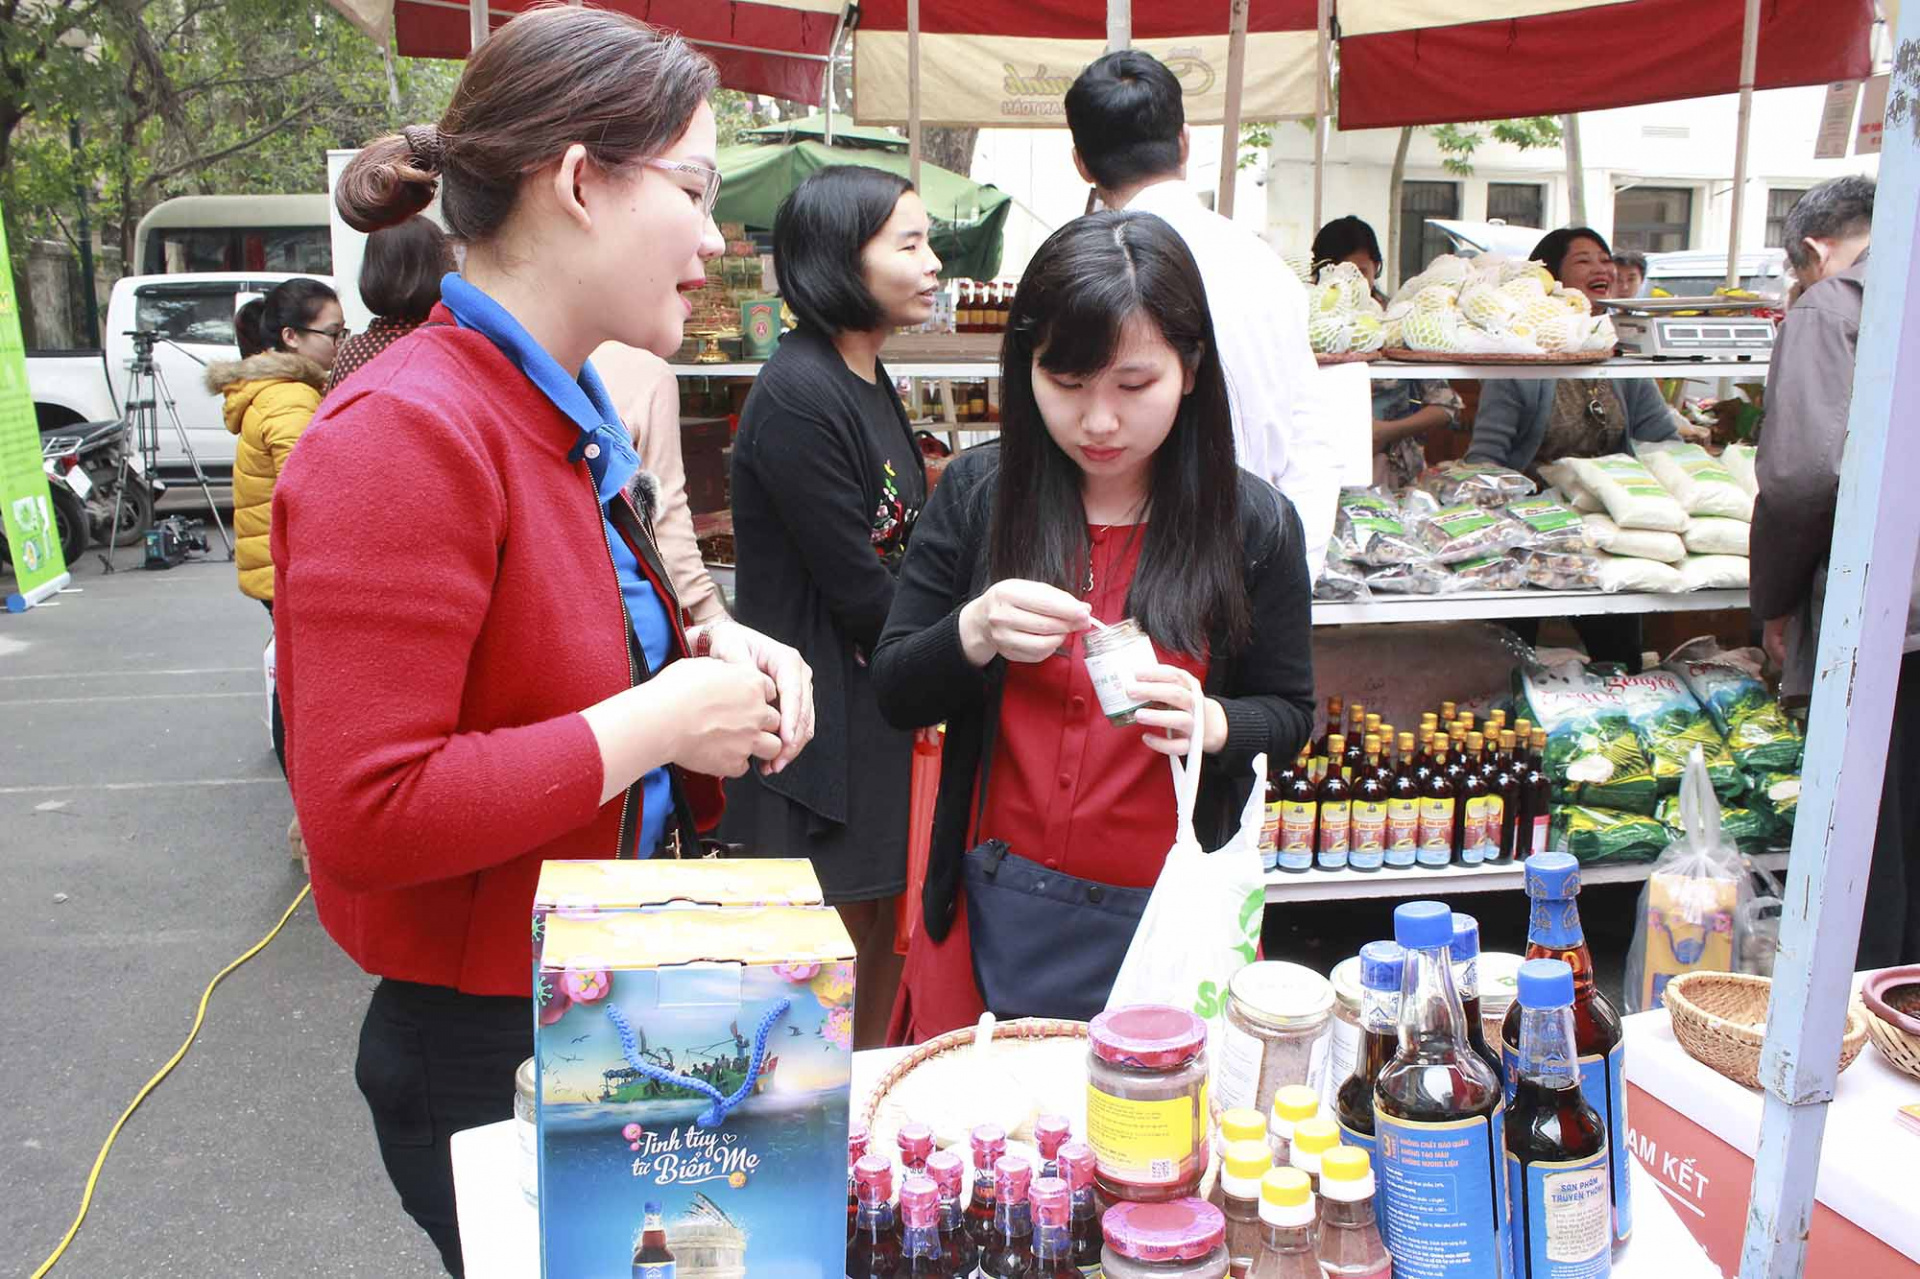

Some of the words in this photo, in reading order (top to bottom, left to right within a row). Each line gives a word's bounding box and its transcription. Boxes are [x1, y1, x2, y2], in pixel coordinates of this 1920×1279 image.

[654, 1152, 714, 1184] Biển
[713, 1147, 760, 1174] Mẹ
[1628, 1128, 1657, 1166] AM
[1662, 1151, 1709, 1199] KẾT
